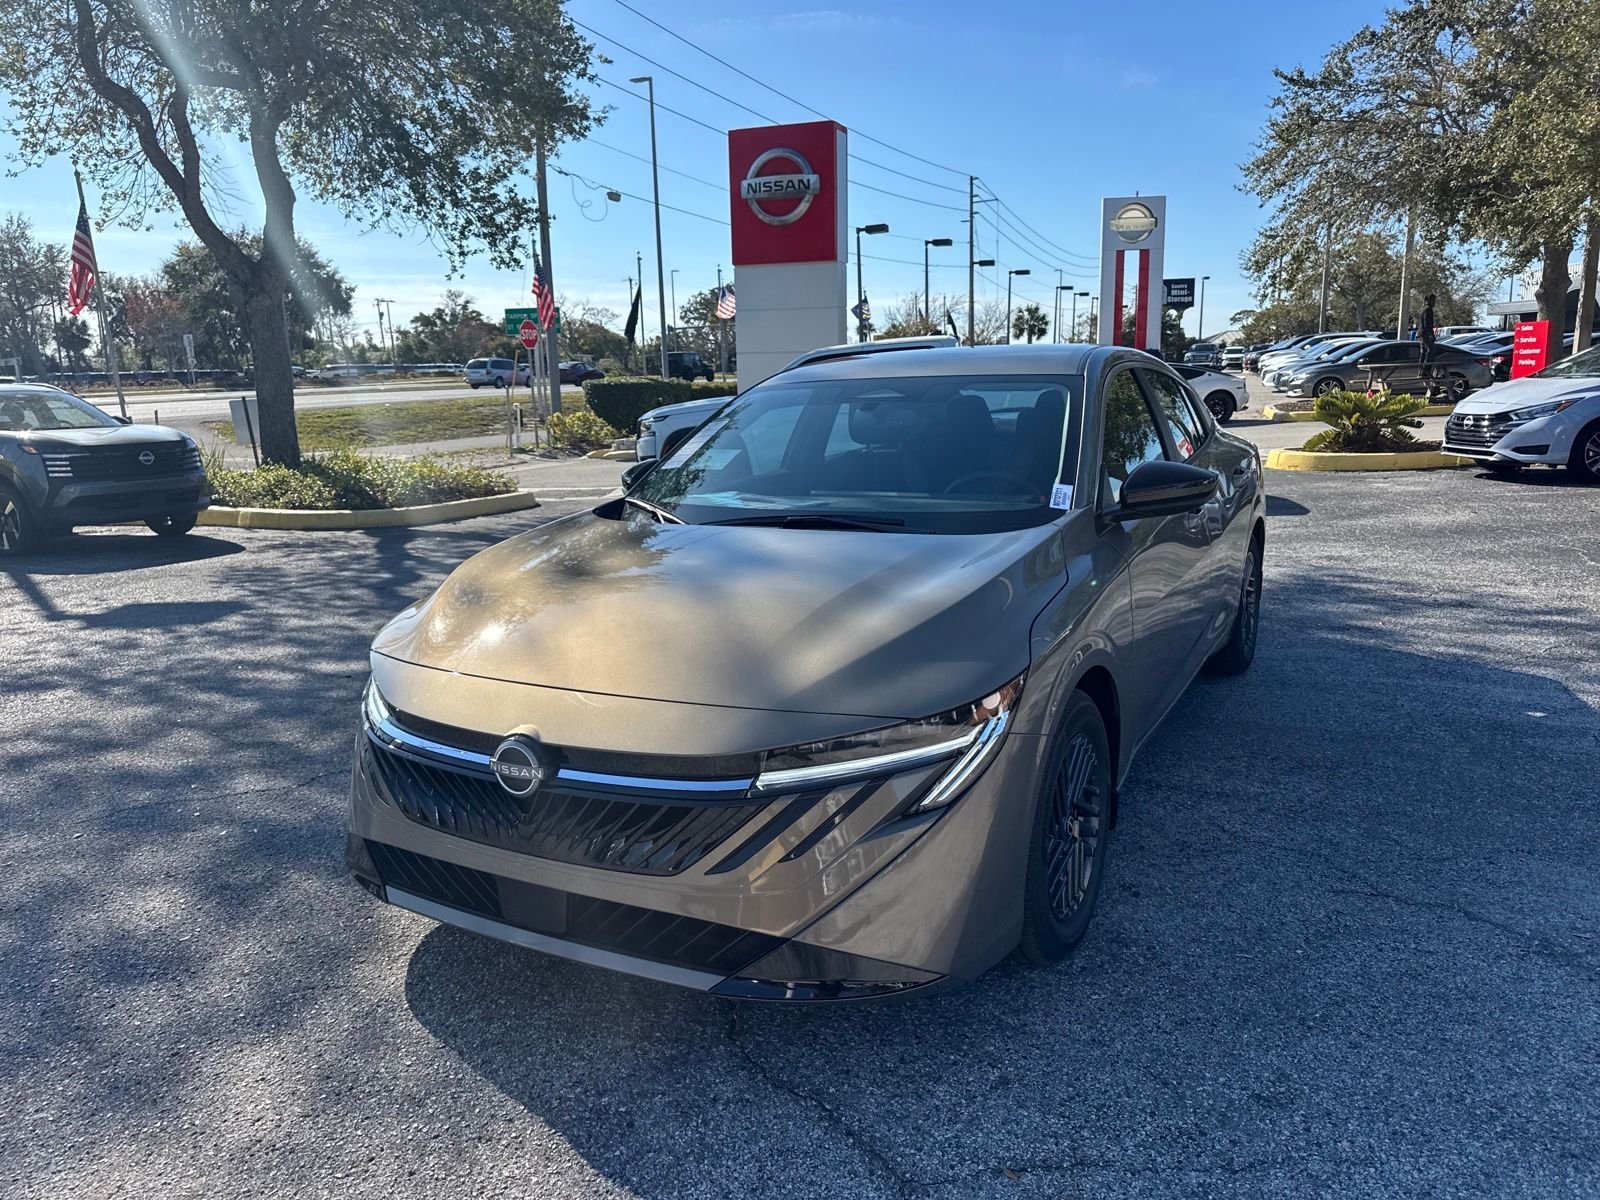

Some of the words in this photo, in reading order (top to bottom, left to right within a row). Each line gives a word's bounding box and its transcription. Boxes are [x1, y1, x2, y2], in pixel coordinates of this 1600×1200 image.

[747, 179, 810, 194] NISSAN
[521, 329, 538, 340] STOP
[490, 761, 542, 778] NISSAN
